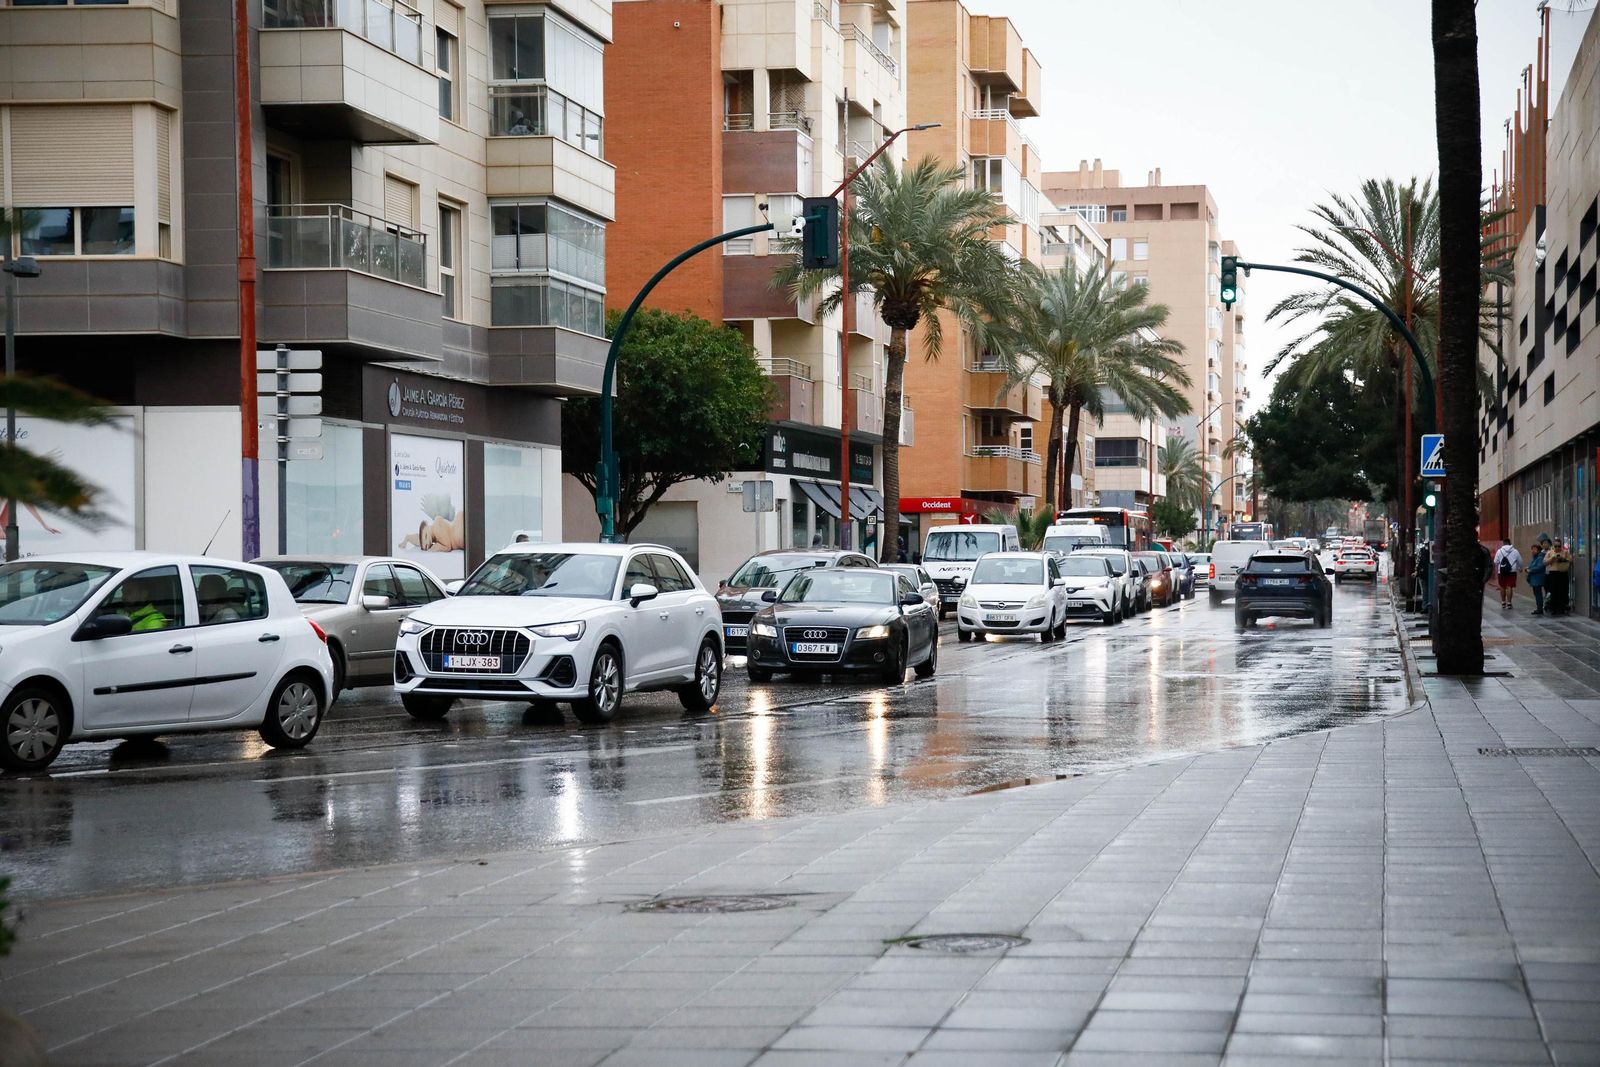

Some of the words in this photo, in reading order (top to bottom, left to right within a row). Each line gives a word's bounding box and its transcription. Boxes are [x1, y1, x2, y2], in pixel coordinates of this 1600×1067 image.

[402, 386, 419, 403] JAIME
[921, 501, 952, 509] Occident
[797, 644, 817, 653] 0367
[451, 656, 499, 668] 1-LJX-383
